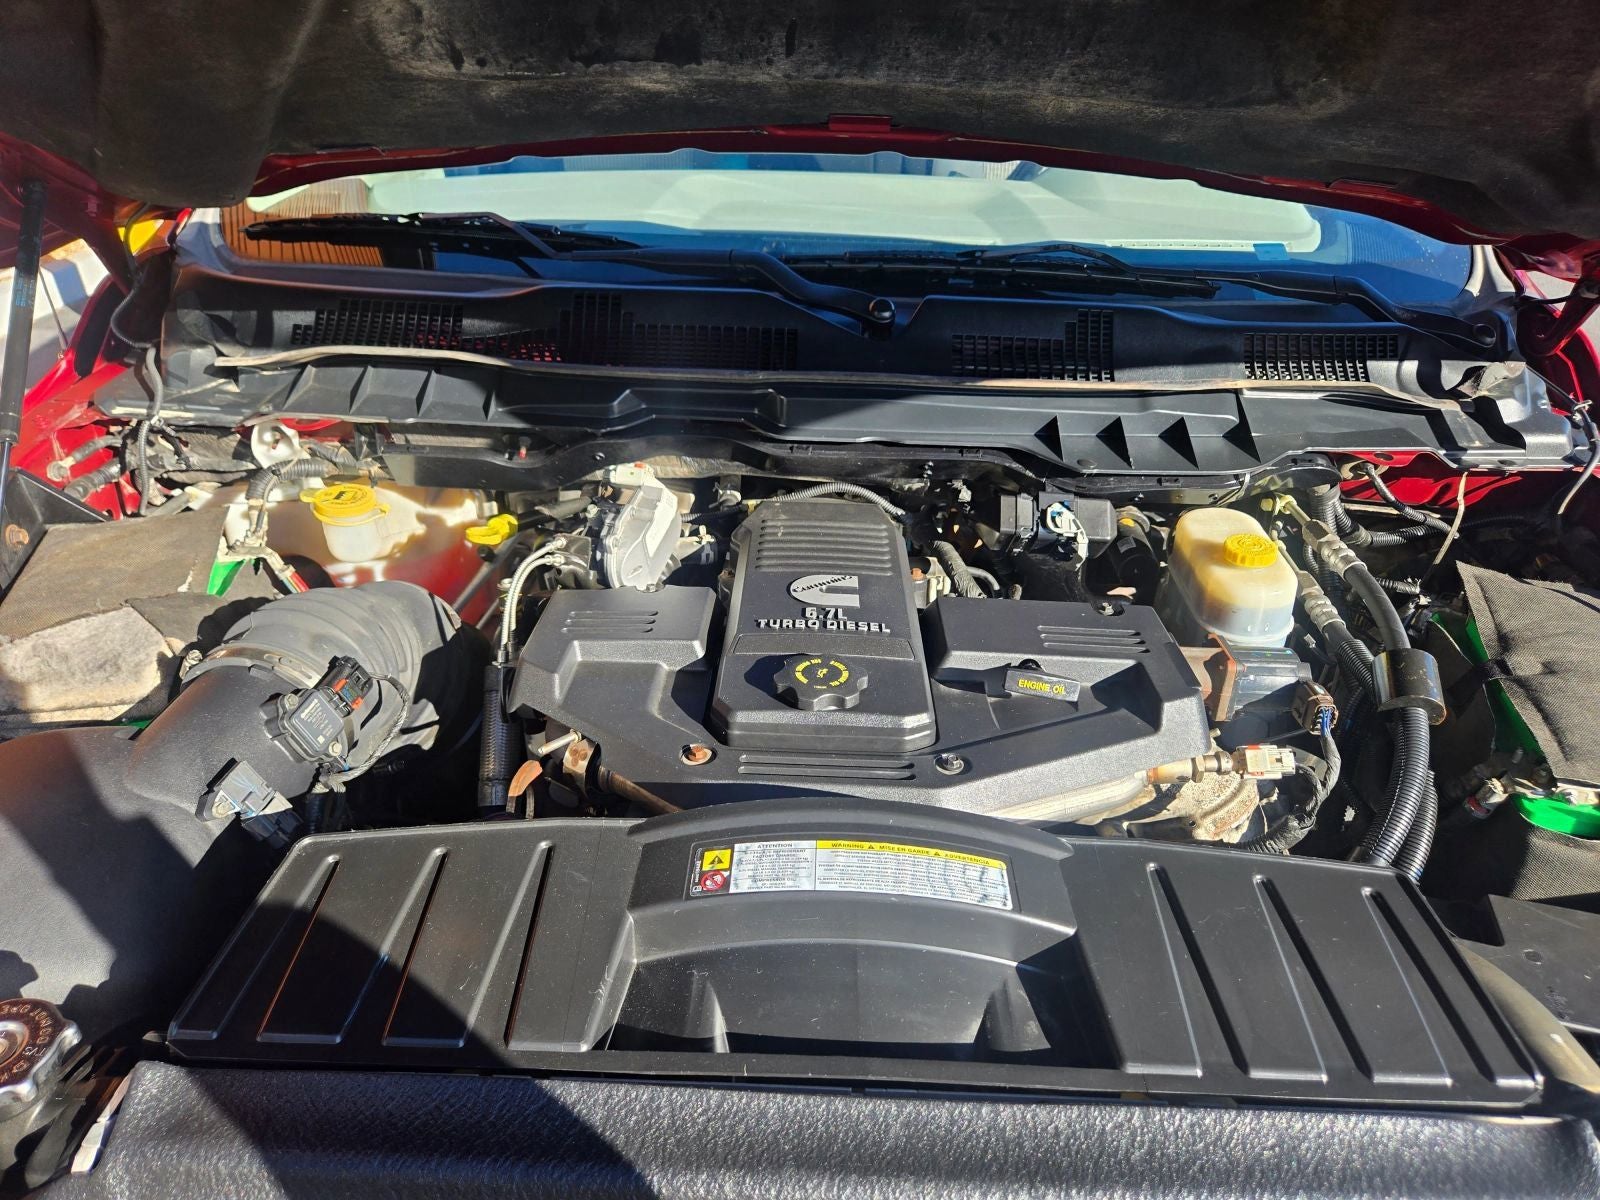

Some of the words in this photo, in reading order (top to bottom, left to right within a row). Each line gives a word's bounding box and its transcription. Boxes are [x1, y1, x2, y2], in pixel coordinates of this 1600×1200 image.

[791, 575, 853, 593] Cummins
[805, 606, 848, 621] 6.7L
[757, 618, 820, 630] TURBO
[826, 620, 891, 633] DIESEL
[1018, 678, 1051, 693] ENGINE
[1052, 683, 1066, 695] OIL
[907, 847, 930, 855] GARDE
[944, 853, 990, 865] ADVERTENCIA
